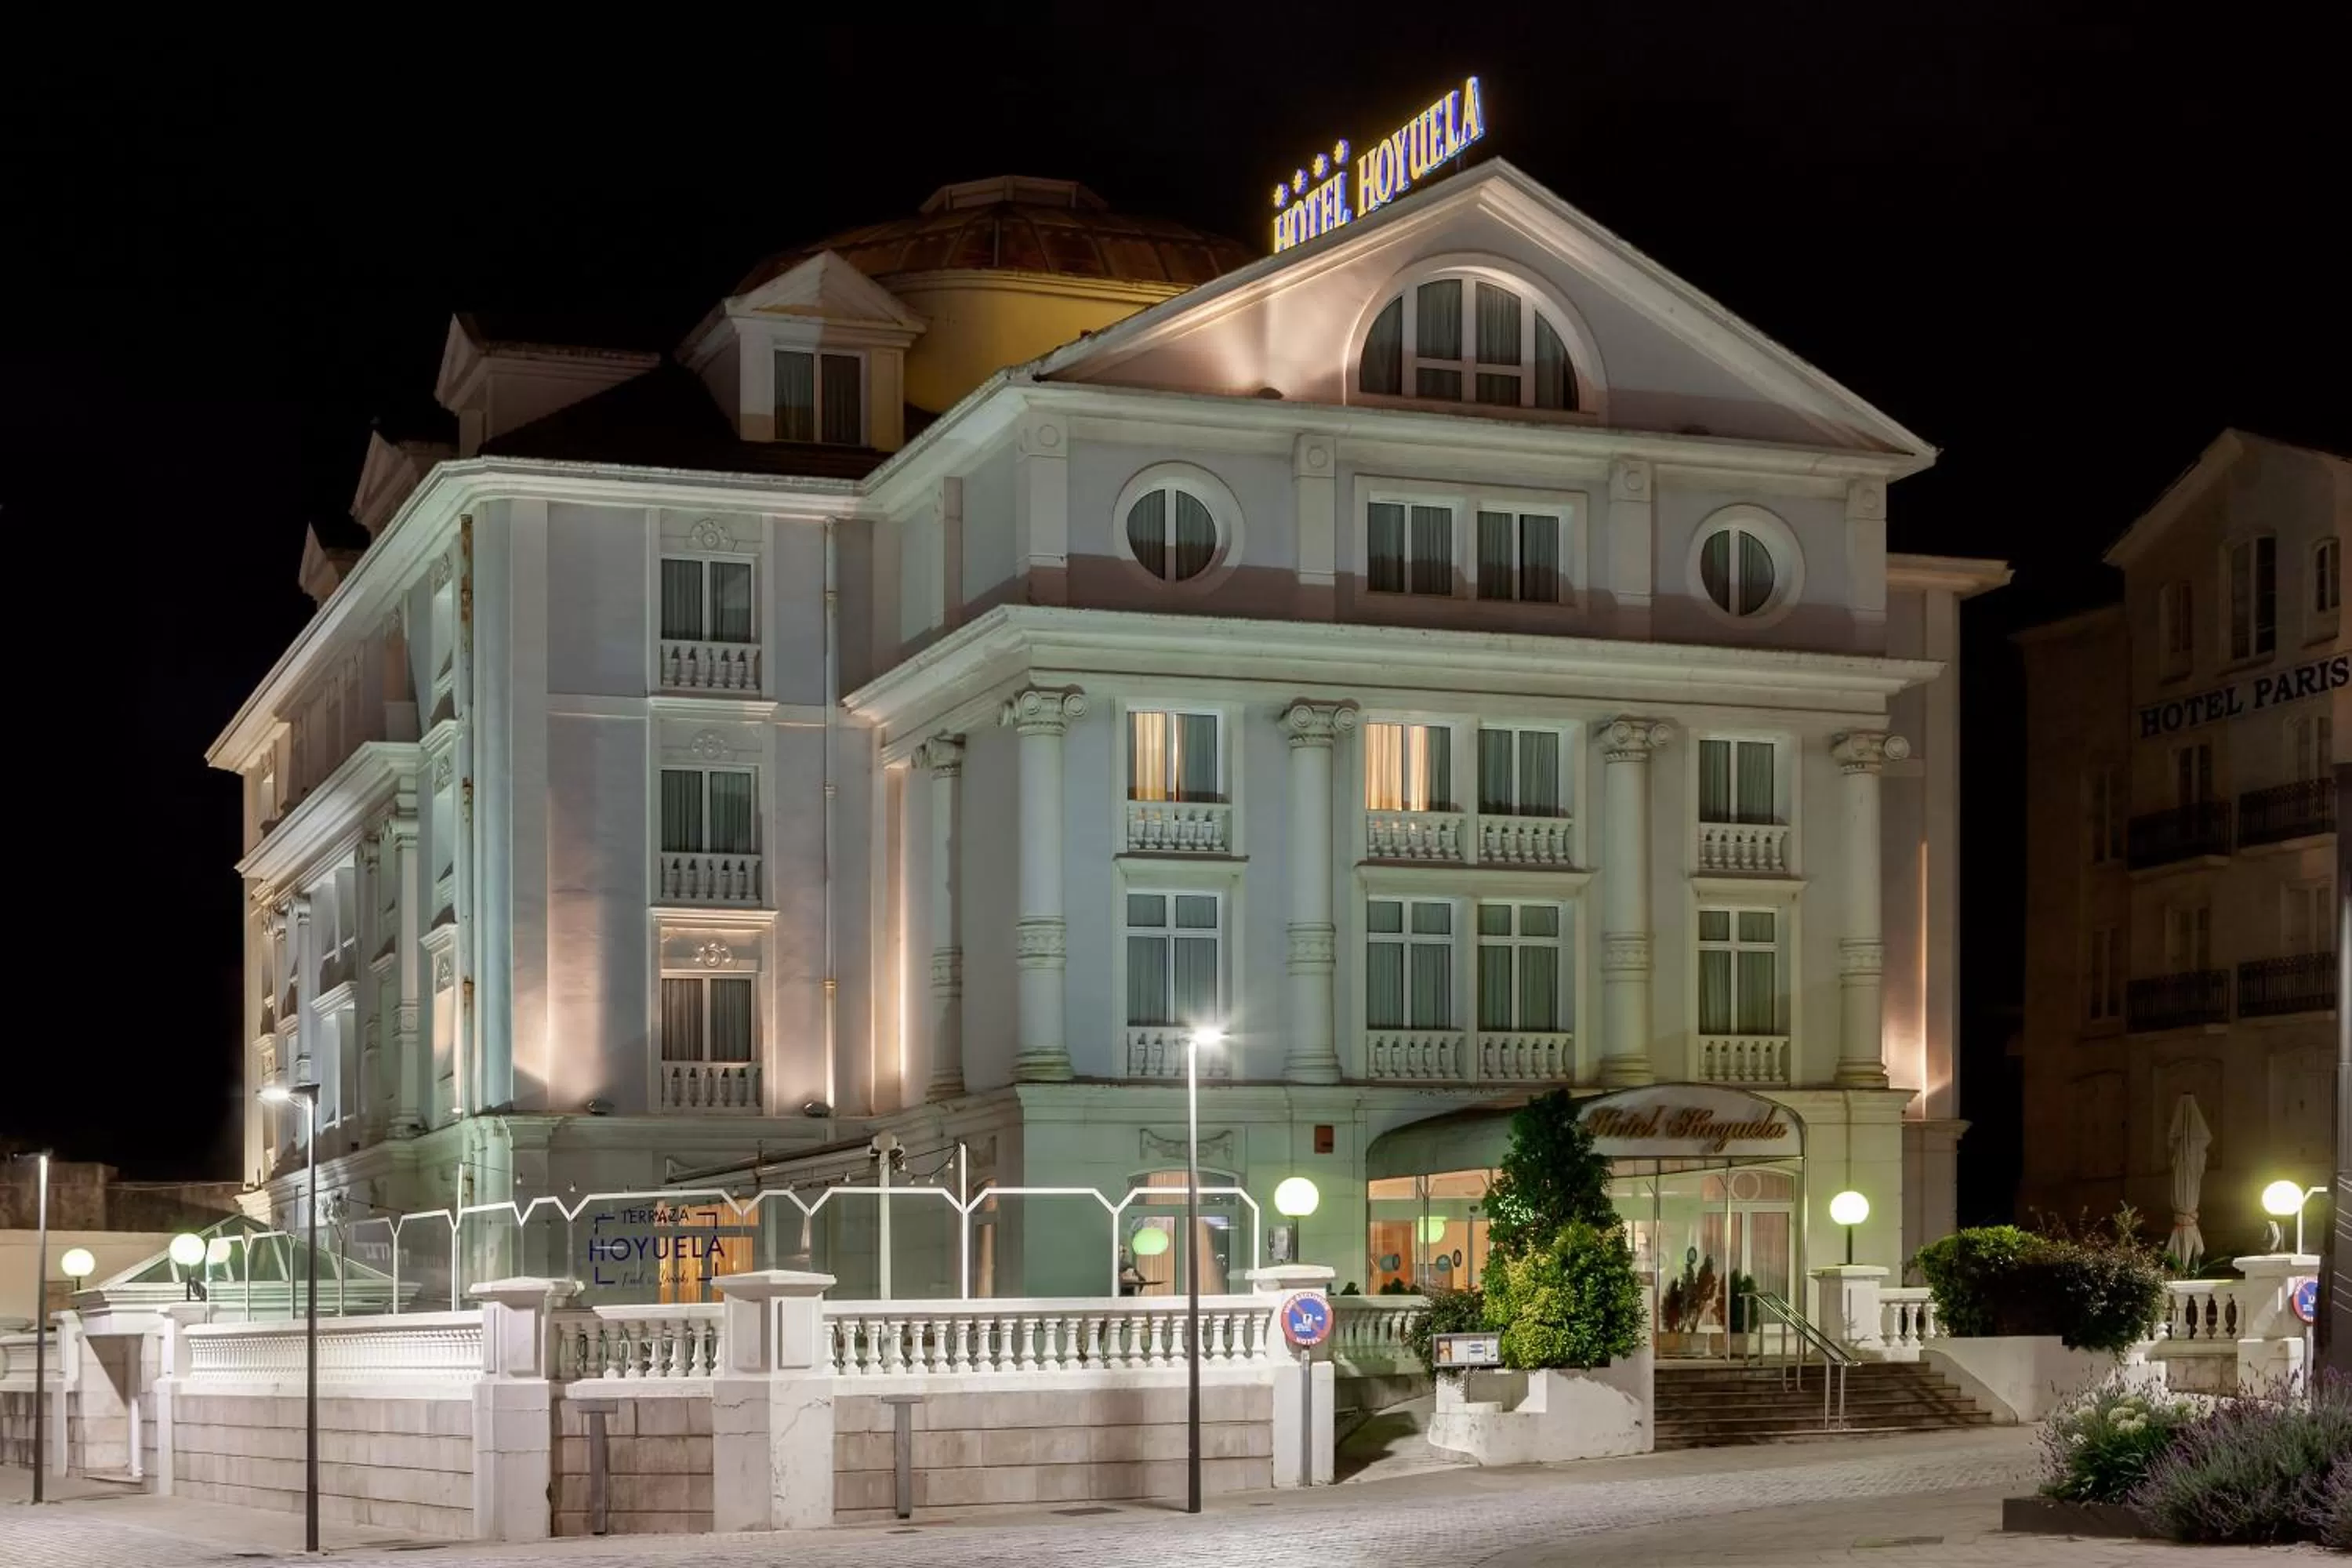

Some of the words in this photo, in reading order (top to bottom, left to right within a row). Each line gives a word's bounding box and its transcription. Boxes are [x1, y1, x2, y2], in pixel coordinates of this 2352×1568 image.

[1273, 171, 1352, 253] HOTEL
[1357, 76, 1485, 217] HOYUELA
[2139, 686, 2244, 739] HOTEL
[2254, 655, 2350, 709] PARIS
[621, 1208, 690, 1224] TERRAZA
[589, 1235, 725, 1261] HOYUELA
